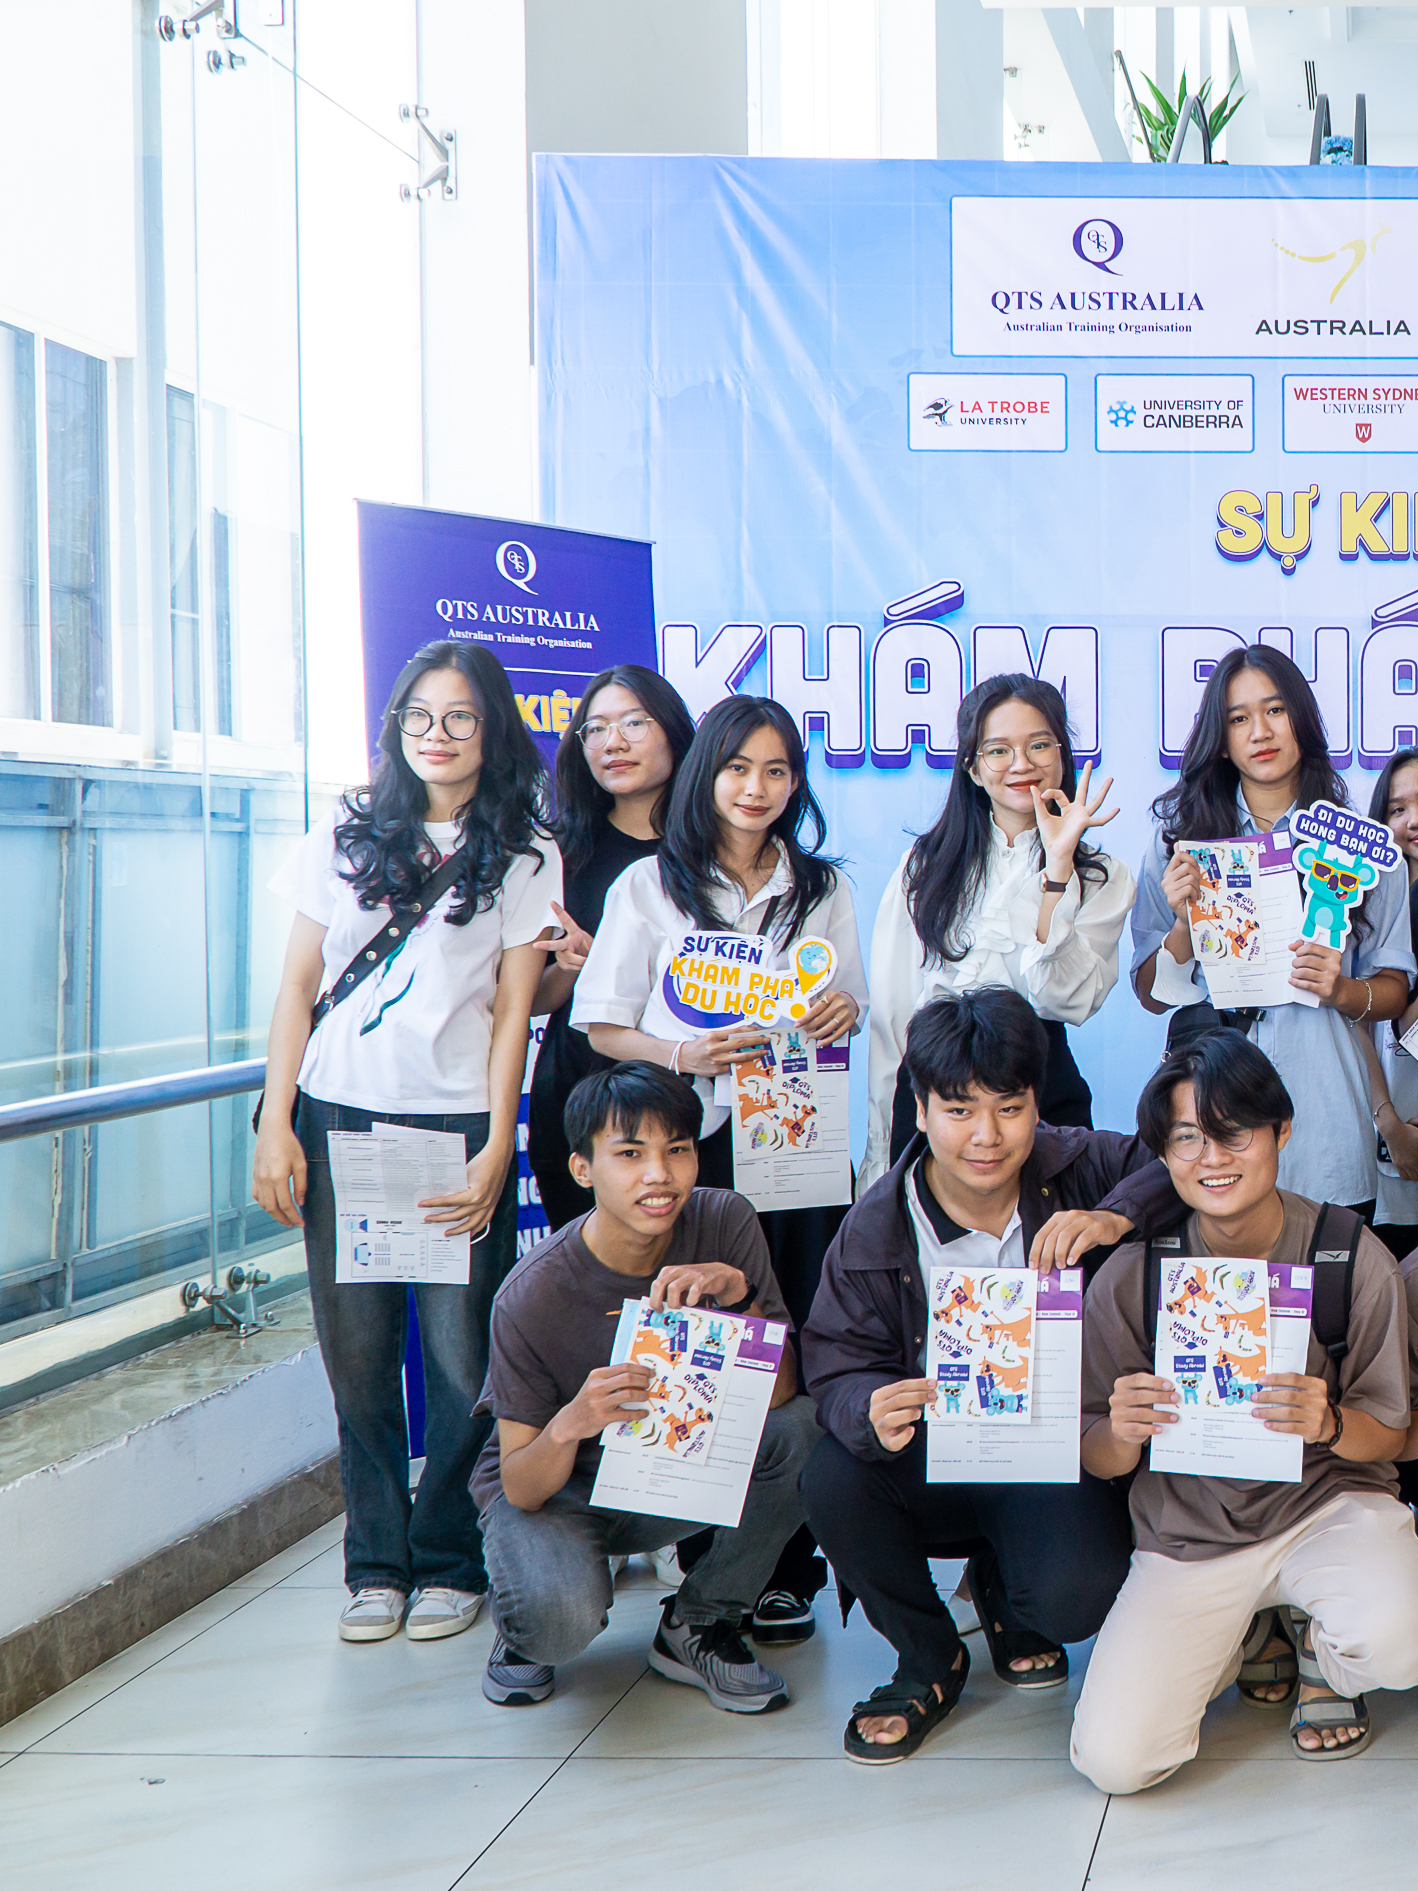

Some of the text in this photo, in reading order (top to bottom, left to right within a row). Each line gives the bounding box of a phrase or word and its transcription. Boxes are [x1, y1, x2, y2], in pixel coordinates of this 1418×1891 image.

[991, 291, 1204, 314] QTS AUSTRALIA
[1003, 321, 1192, 334] Australian Training Organisation
[1255, 319, 1411, 336] AUSTRALIA
[1143, 400, 1243, 410] UNIVERSITY OF
[1293, 387, 1368, 401] WESTERN
[960, 401, 1050, 414] LA TROBE
[1322, 403, 1405, 414] UNIVERSITY
[960, 417, 1027, 425] UNIVERSITY
[1143, 414, 1243, 429] CANBERRA
[1215, 484, 1320, 576] SỰ
[435, 598, 600, 632] QTS AUSTRALIA
[447, 628, 593, 650] Australian Training Organisation
[659, 578, 1102, 769] KHÁM
[514, 690, 583, 740] KIỆ
[1317, 808, 1386, 845] ĐI DU HỌC
[1300, 818, 1394, 863] HONG BẠN ƠI?
[682, 935, 763, 965] SỰ KIỆN
[670, 956, 796, 999] KHÁM PHÁ
[681, 982, 776, 1021] DU HỌC
